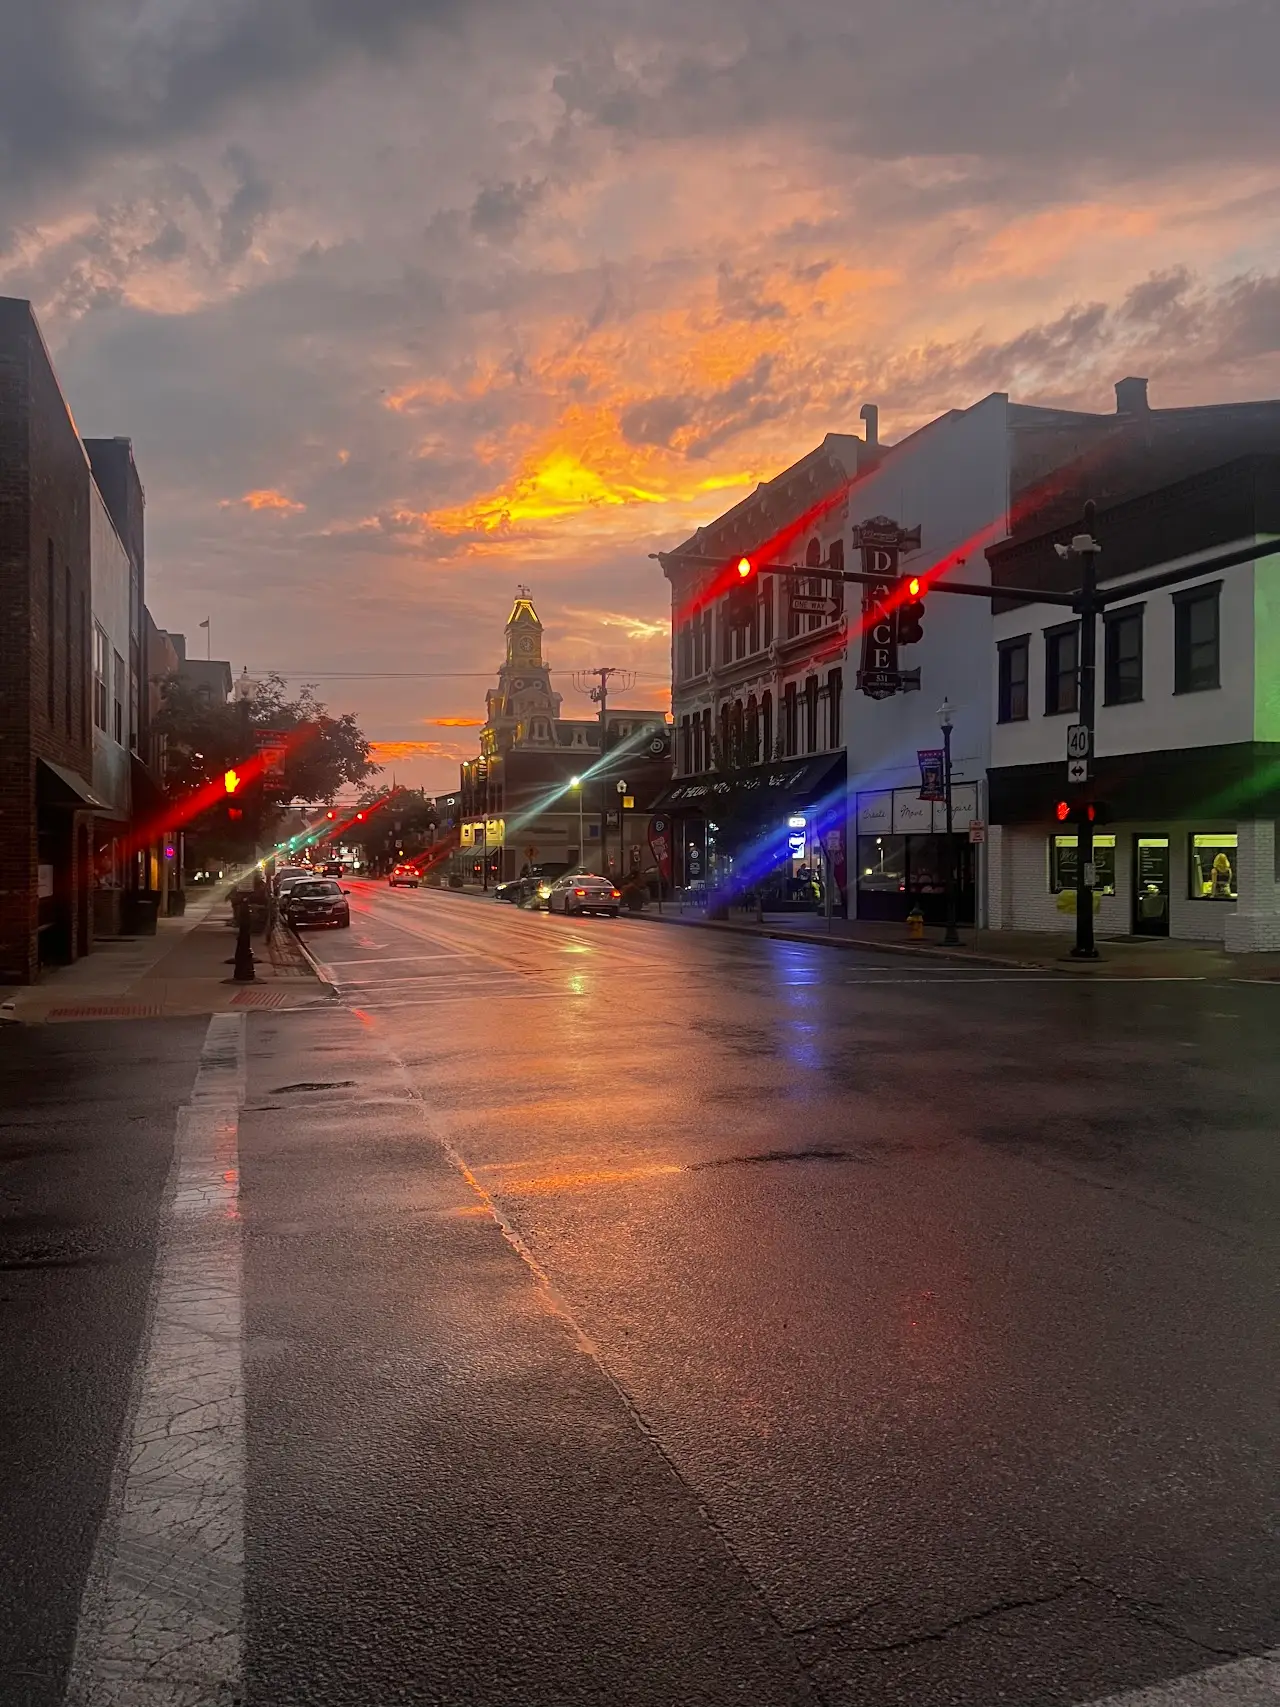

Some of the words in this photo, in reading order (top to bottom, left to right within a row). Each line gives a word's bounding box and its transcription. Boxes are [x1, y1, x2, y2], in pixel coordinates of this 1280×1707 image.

[794, 600, 808, 609] ONE
[811, 602, 825, 610] WAY
[876, 674, 888, 683] 531
[1070, 732, 1085, 751] 40
[900, 804, 924, 819] Move
